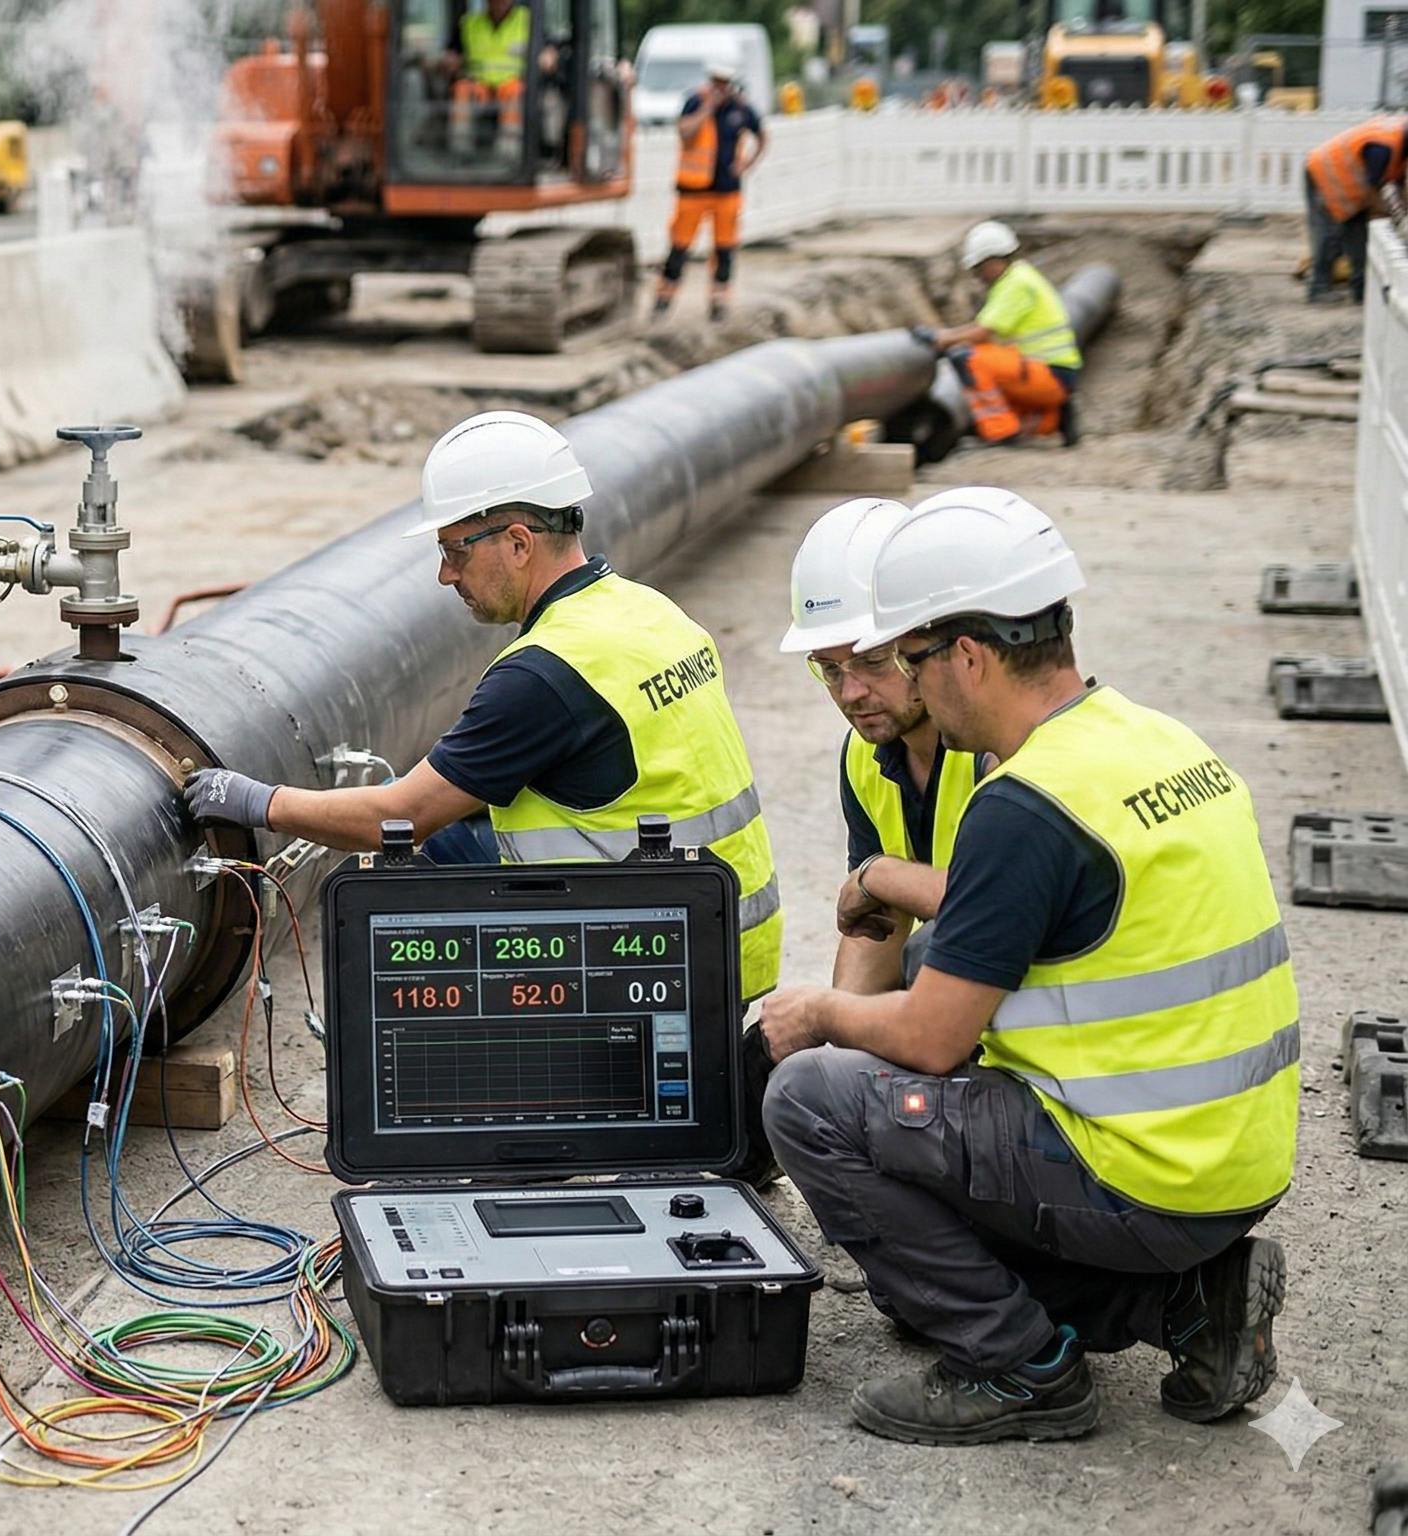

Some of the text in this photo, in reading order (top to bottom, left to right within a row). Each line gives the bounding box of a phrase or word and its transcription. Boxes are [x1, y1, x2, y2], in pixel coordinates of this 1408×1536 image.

[390, 939, 460, 962] 269.0
[495, 936, 564, 960] 236.0
[612, 934, 666, 957] 44.0
[392, 985, 461, 1009] 118.0
[512, 983, 565, 1006] 52.0
[628, 980, 668, 1003] 0.0
